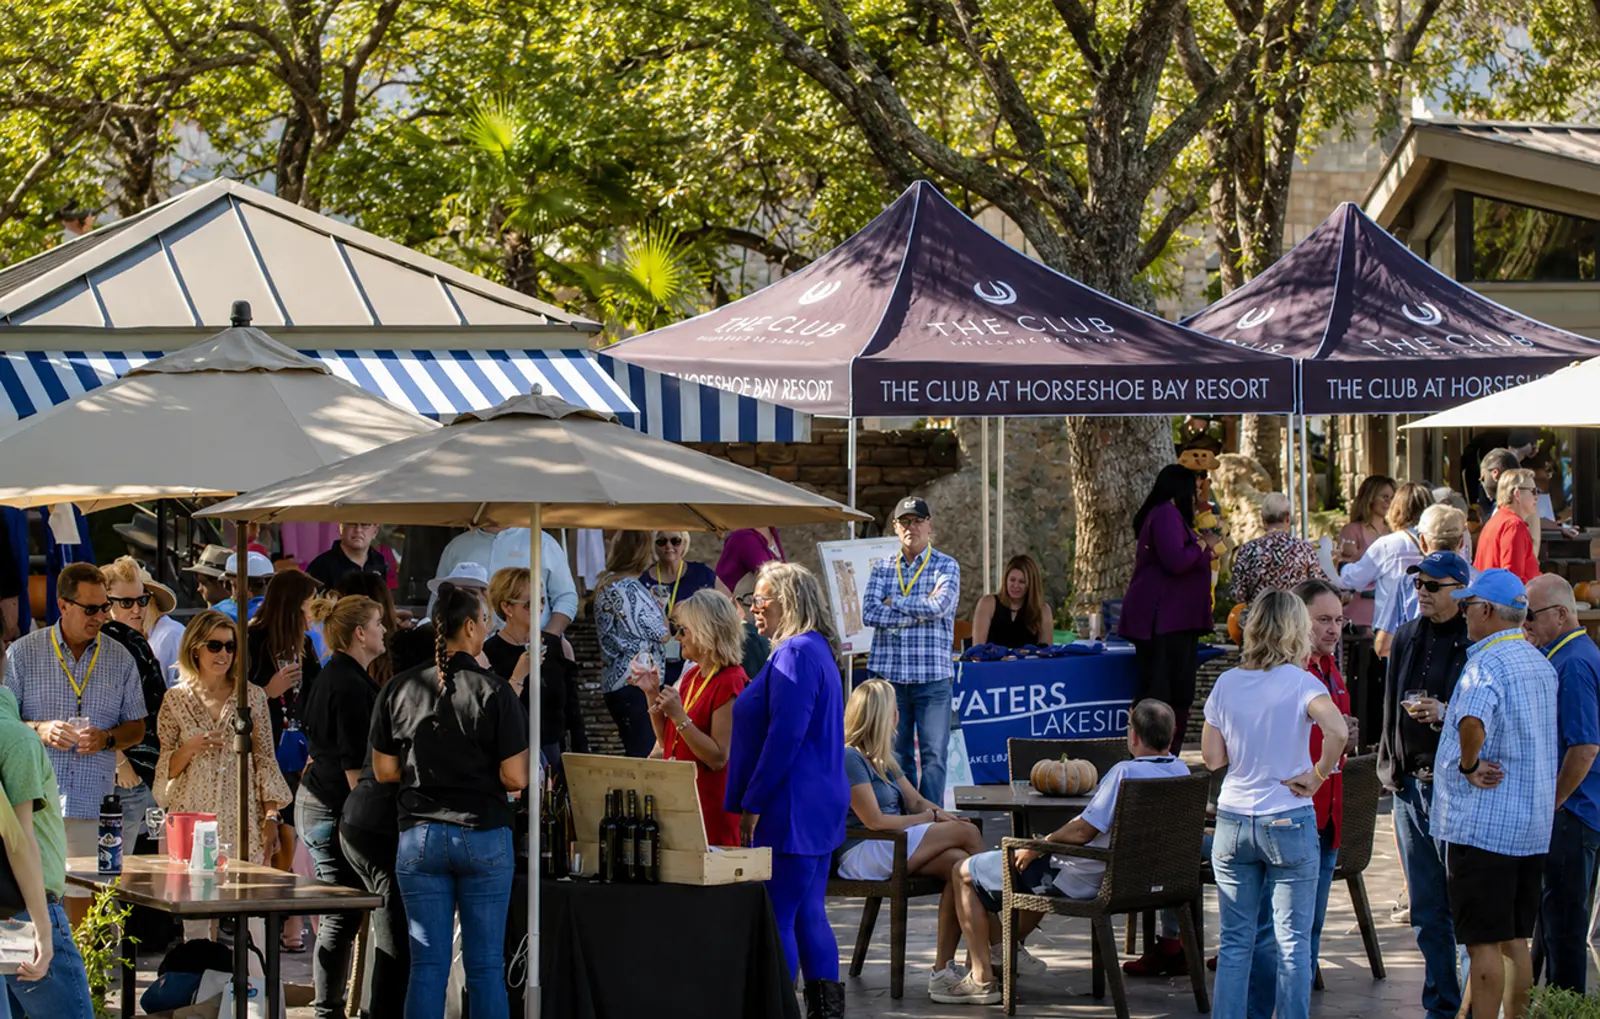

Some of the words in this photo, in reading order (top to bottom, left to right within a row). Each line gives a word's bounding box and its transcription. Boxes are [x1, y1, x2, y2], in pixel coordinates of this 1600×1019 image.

[714, 316, 772, 333] THE
[768, 316, 846, 338] CLUB
[927, 317, 1009, 337] THE
[1017, 315, 1115, 333] CLUB
[1362, 336, 1441, 352] THE
[1446, 334, 1534, 347] CLUB
[752, 376, 779, 400] BAY
[781, 378, 833, 401] RESORT
[880, 380, 919, 402] THE
[926, 380, 980, 402] CLUB
[986, 380, 1010, 401] AT
[1017, 379, 1145, 401] HORSESHOE
[1152, 379, 1189, 400] BAY
[1195, 378, 1269, 400] RESORT
[1327, 378, 1362, 399] THE
[1368, 378, 1418, 399] CLUB
[1422, 377, 1446, 398] AT
[1451, 373, 1550, 397] HORSES
[968, 754, 989, 764] AKE
